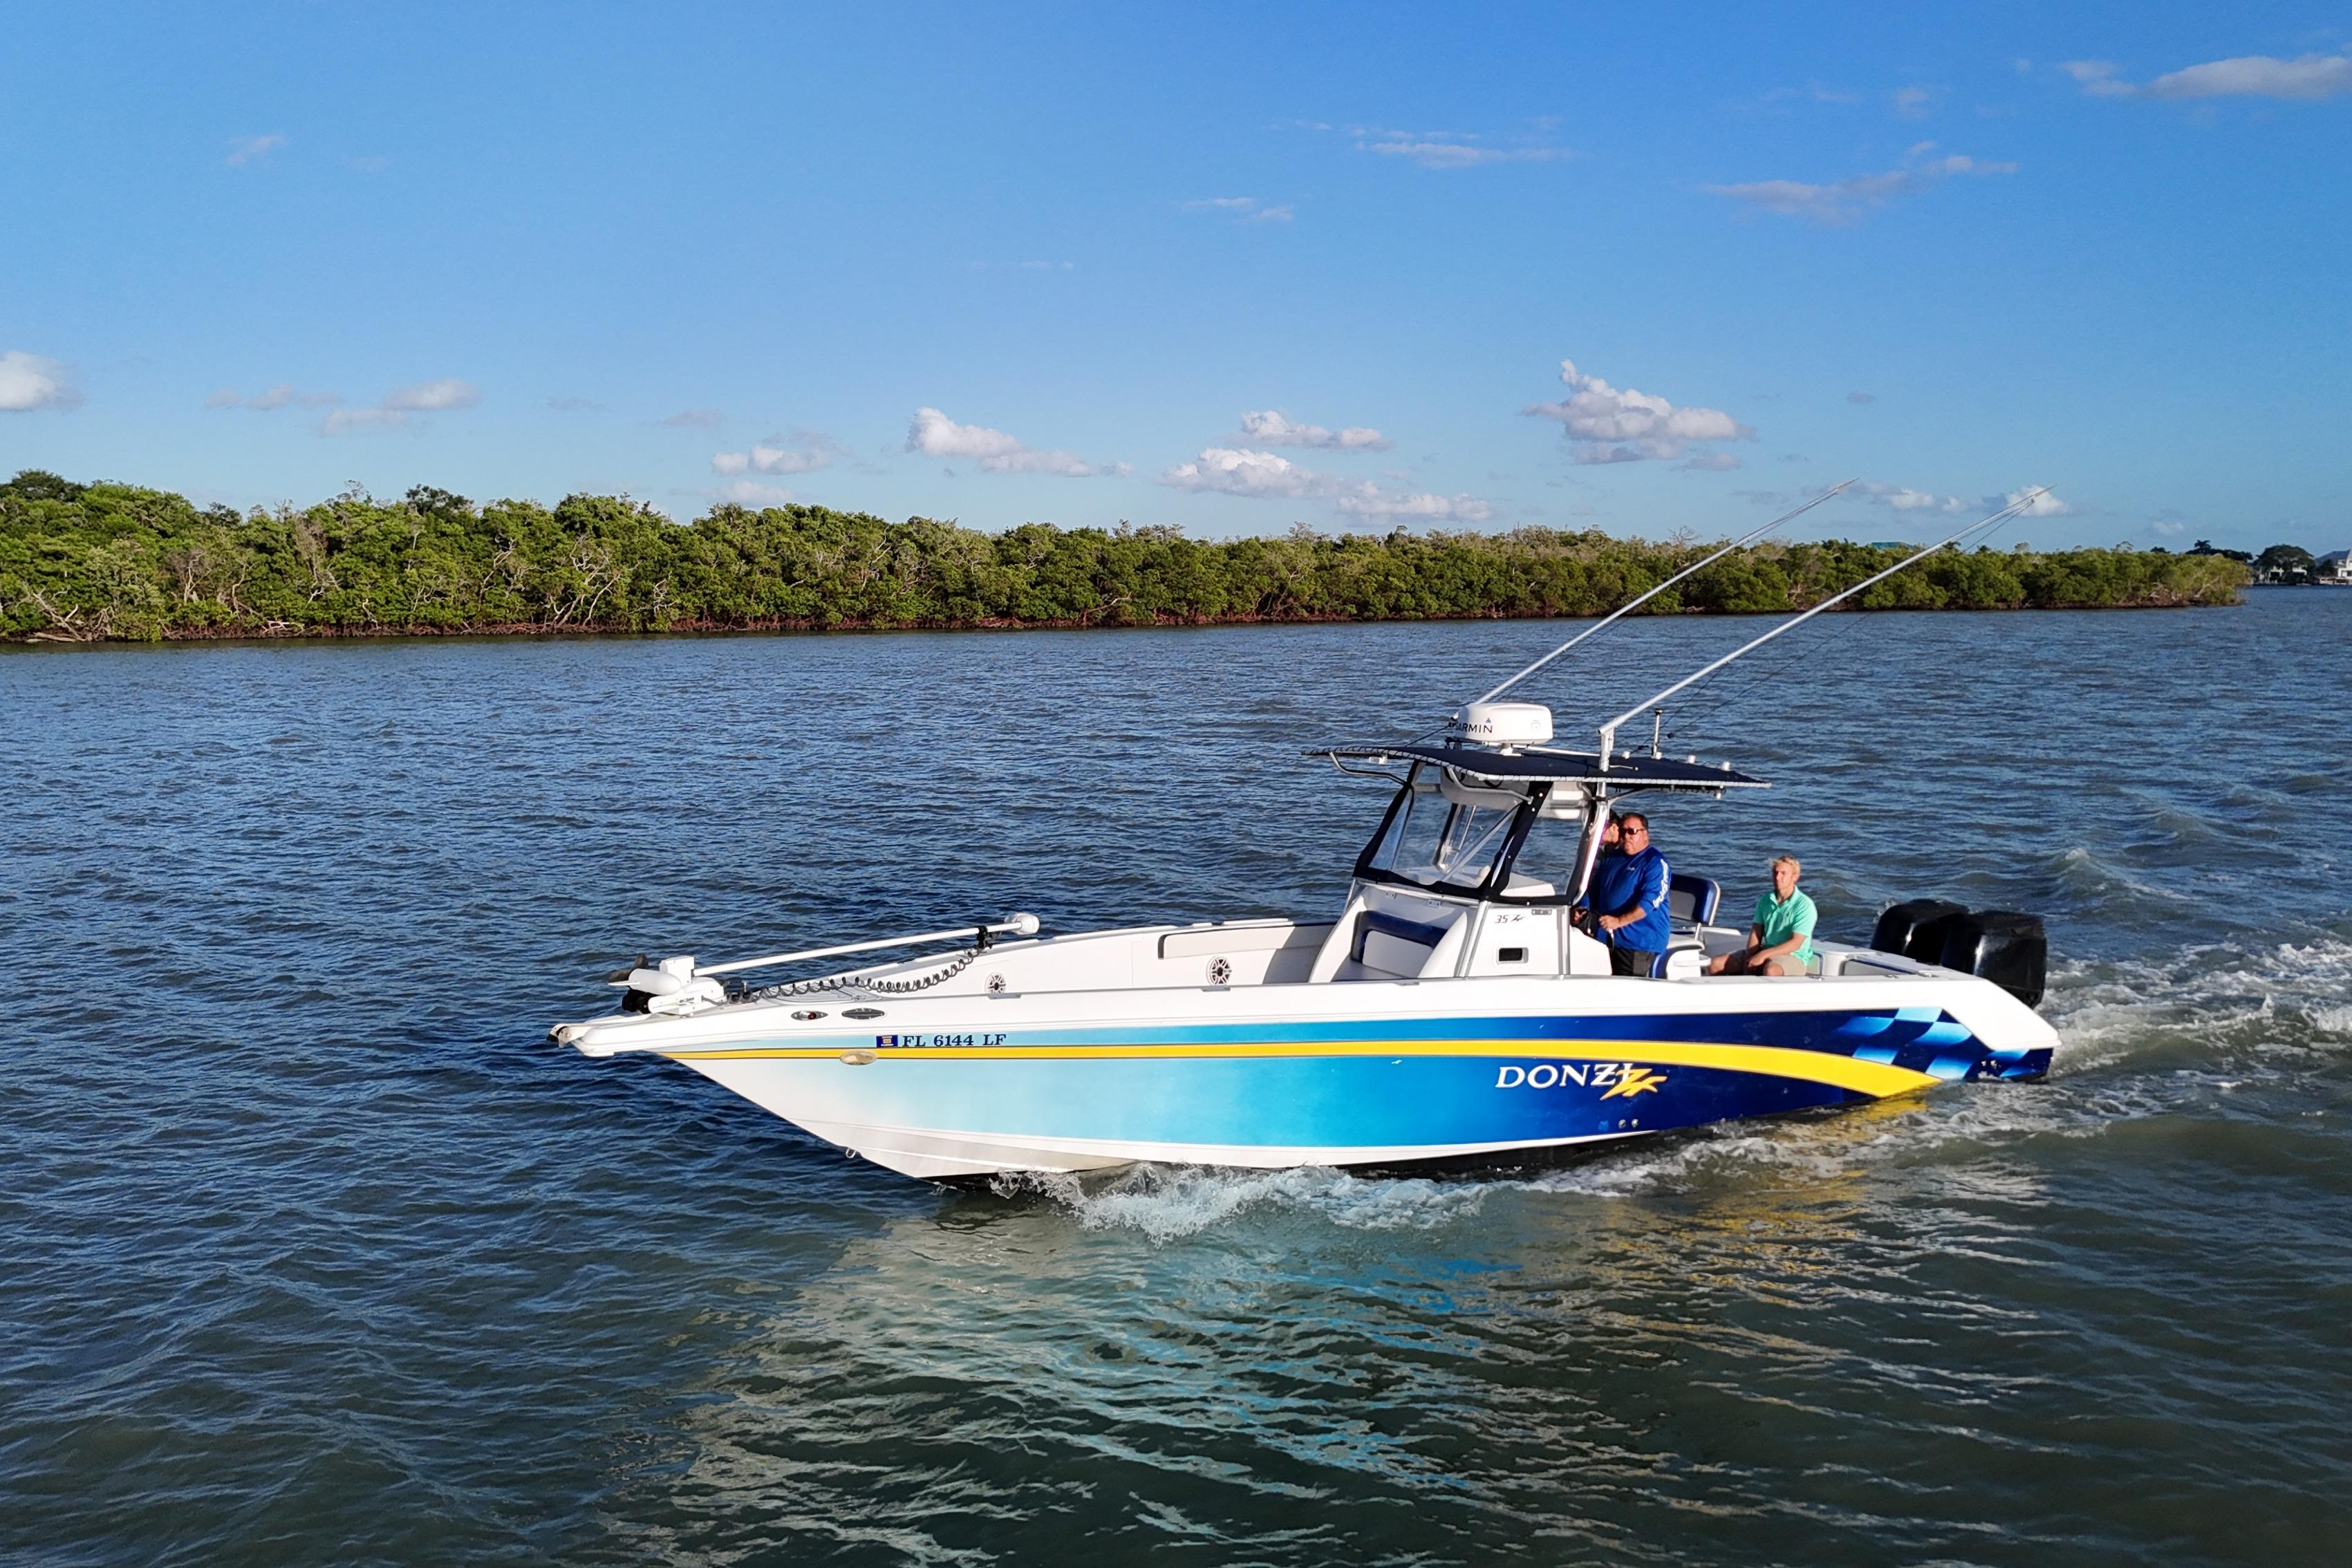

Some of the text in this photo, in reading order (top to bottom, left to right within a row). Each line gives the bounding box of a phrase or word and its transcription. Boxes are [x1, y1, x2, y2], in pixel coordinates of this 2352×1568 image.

[1495, 914, 1509, 924] 35
[902, 1034, 1007, 1047] FL 6144 LF
[1495, 1063, 1633, 1089] DONZI
